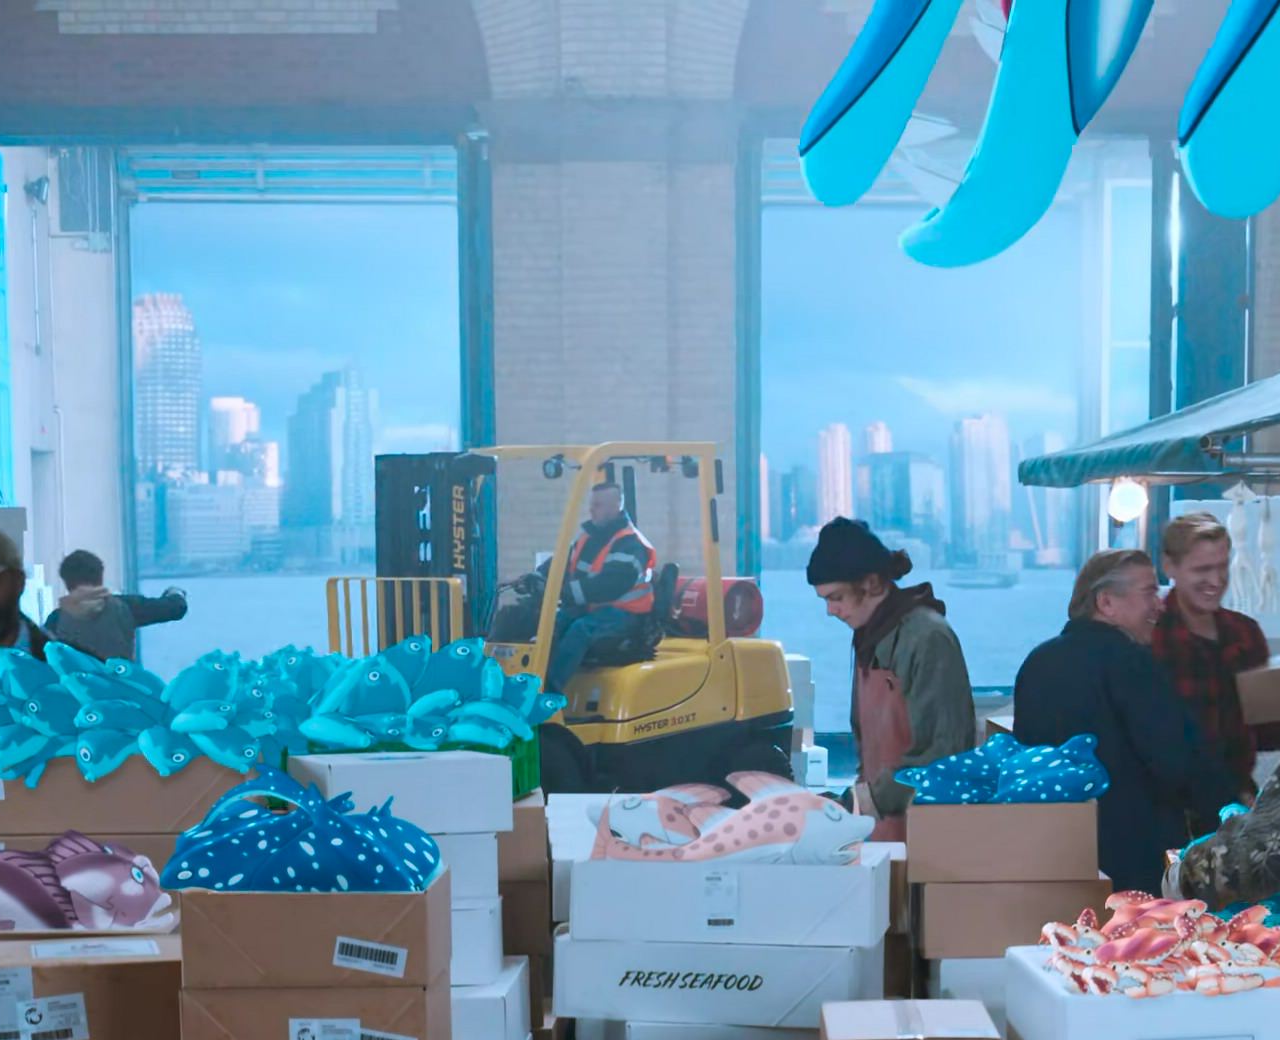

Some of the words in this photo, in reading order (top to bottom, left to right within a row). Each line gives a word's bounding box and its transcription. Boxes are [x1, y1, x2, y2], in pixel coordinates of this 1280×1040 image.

[452, 485, 465, 569] HYSTER
[633, 718, 669, 736] HYSTER
[618, 970, 680, 989] FRESH
[679, 971, 764, 991] SEAFOOD
